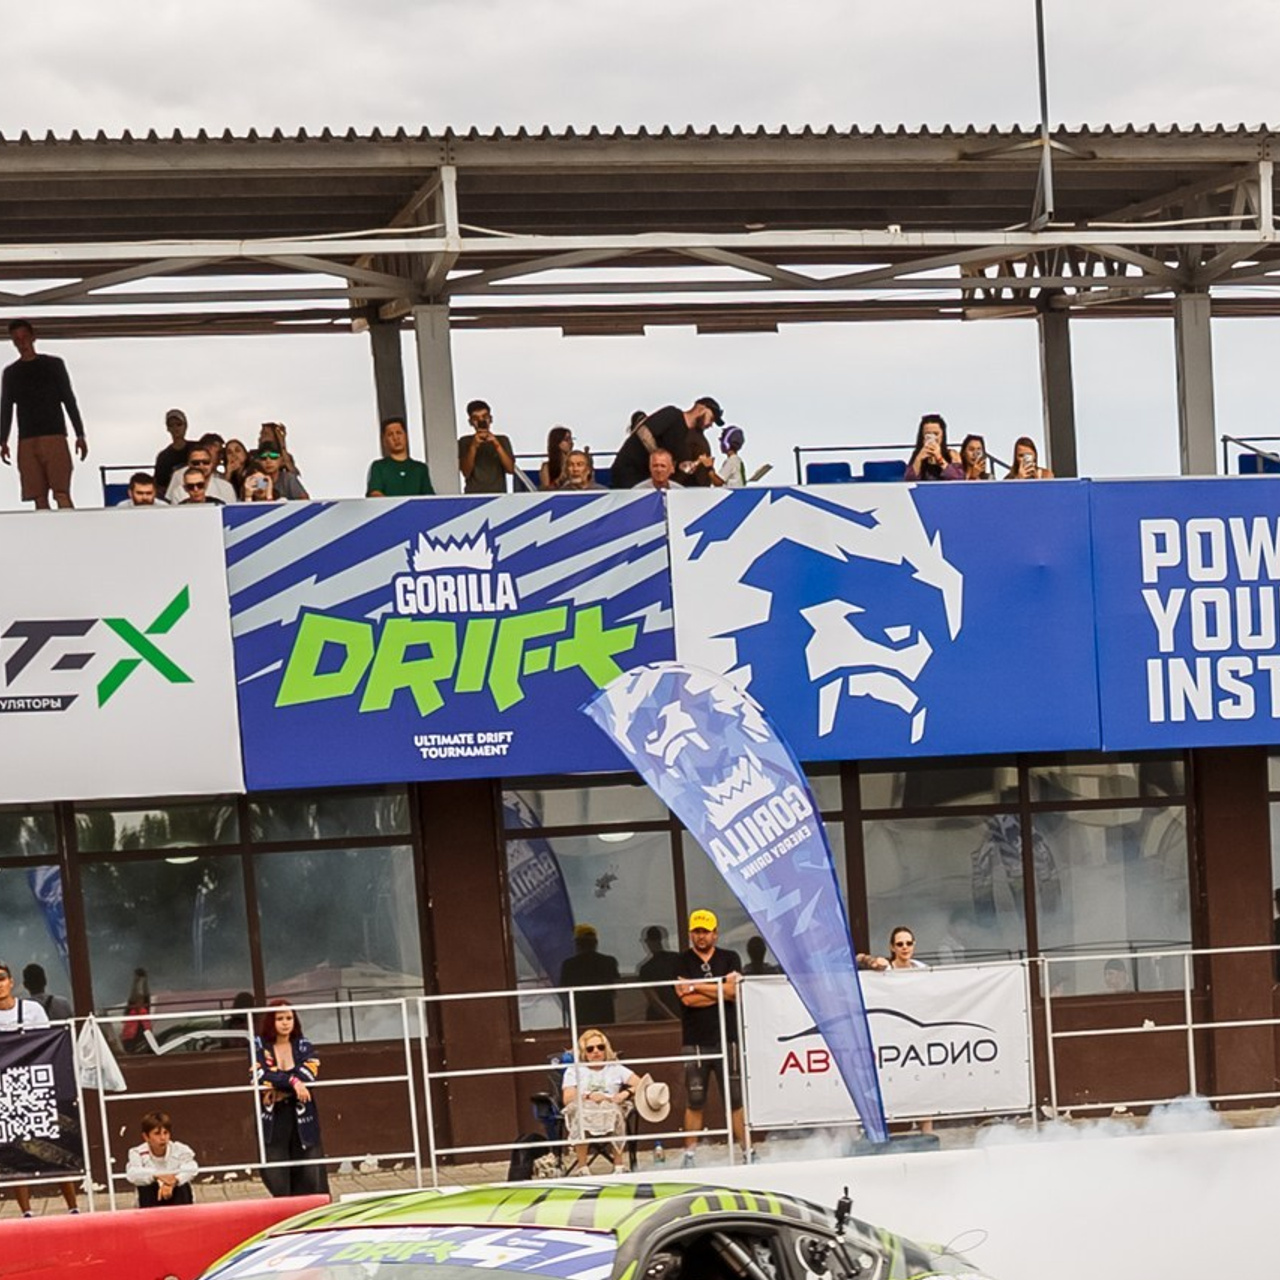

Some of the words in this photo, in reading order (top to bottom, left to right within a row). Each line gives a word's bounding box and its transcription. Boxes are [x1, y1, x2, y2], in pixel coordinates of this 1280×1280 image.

[395, 573, 518, 614] GORILLA
[274, 605, 638, 717] DRIFT
[414, 733, 475, 746] ULTIMATE
[477, 731, 513, 744] DRIFT
[419, 745, 509, 759] TOURNAMENT
